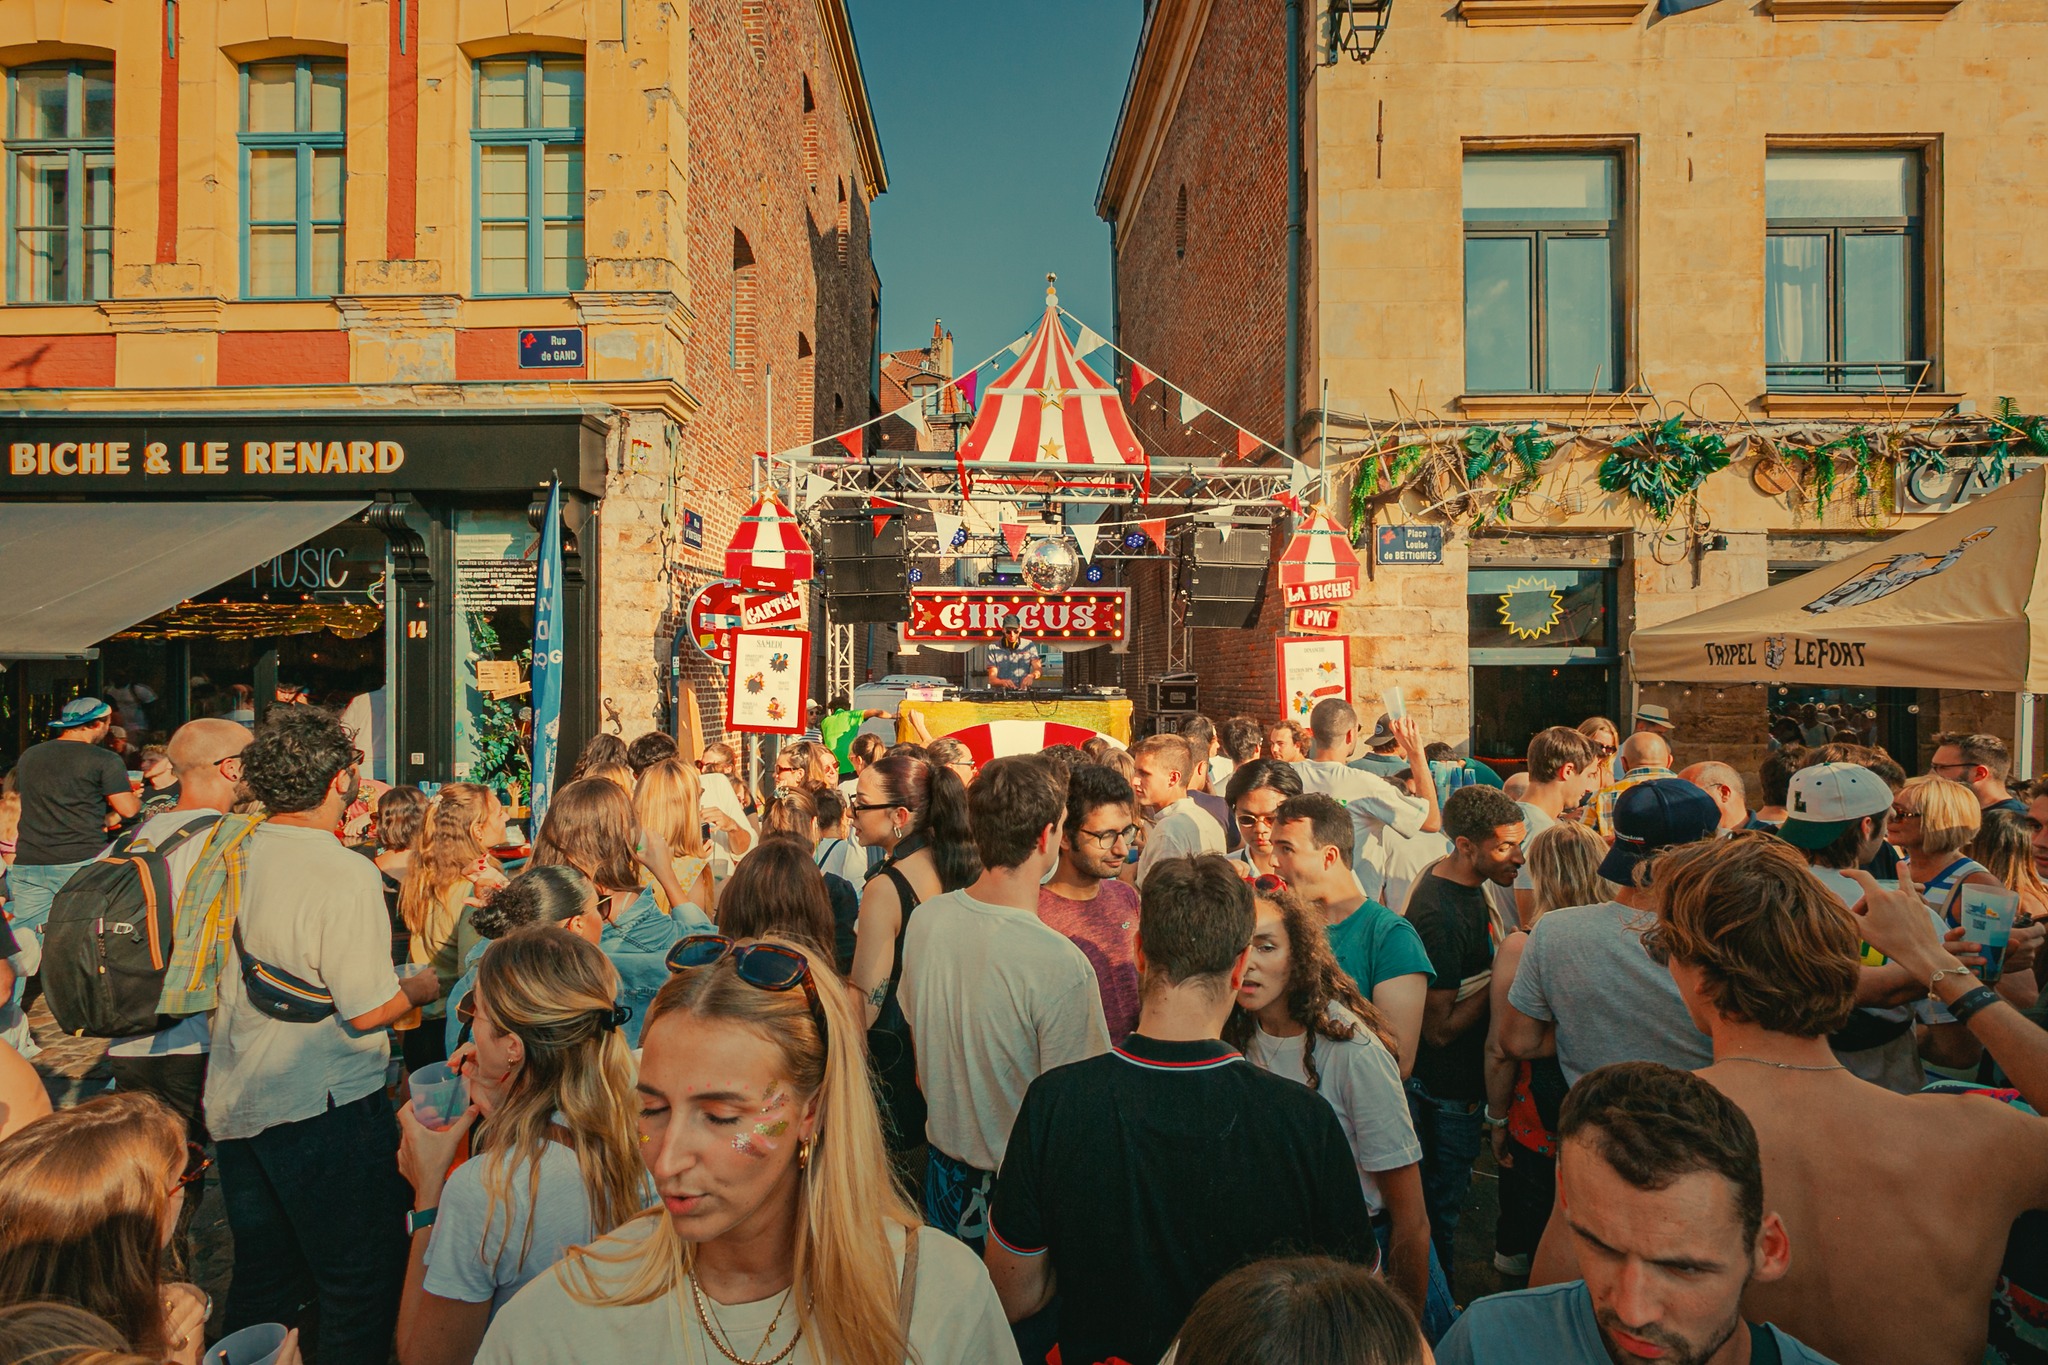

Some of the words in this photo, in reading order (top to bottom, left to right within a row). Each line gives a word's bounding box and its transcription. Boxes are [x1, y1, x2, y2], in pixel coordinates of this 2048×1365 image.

[551, 335, 567, 346] Rue
[541, 351, 552, 361] de
[553, 350, 577, 361] GAND
[10, 442, 130, 475] BICHE
[144, 442, 171, 474] &
[181, 442, 229, 475] LE
[243, 441, 405, 474] RENARD
[1407, 529, 1427, 538] Place
[1405, 540, 1429, 549] Louise
[1384, 551, 1393, 560] de
[1394, 551, 1437, 560] BETTIGNIES
[1287, 586, 1307, 602] LA
[1309, 581, 1352, 601] BICHE
[746, 592, 800, 624] CARTEL
[938, 603, 1097, 630] CIRCUS
[1303, 608, 1332, 627] PNY
[407, 620, 427, 639] 14
[756, 640, 783, 649] SAMEDI
[1704, 642, 1757, 666] TRIPEL
[1794, 790, 1807, 813] L
